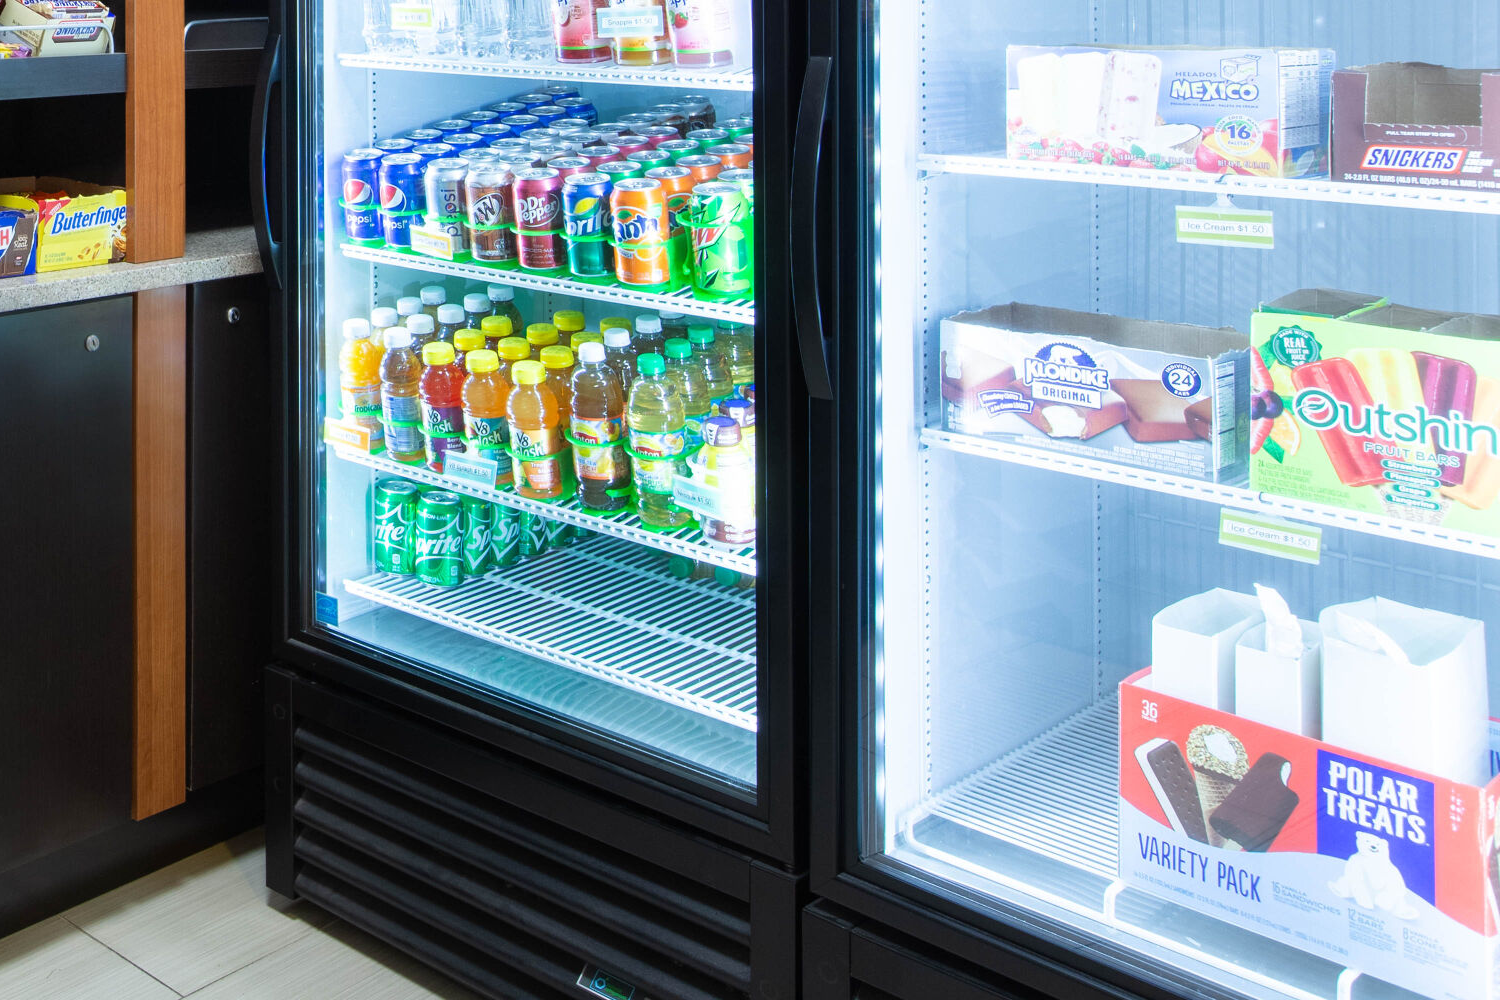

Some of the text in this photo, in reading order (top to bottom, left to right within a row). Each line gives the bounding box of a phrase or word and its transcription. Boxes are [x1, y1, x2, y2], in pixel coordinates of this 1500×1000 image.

[1170, 79, 1260, 102] MEXICO
[1227, 124, 1251, 140] 16
[1367, 148, 1458, 169] SNICKERS
[51, 206, 126, 235] Butterfinge
[347, 214, 372, 225] pepsi
[1187, 222, 1265, 234] Ice Cream $1.50
[1283, 337, 1307, 348] REAL
[1026, 358, 1108, 389] KLONDIKE
[1164, 363, 1198, 377] INDIVIDUAL
[1171, 372, 1192, 387] 24
[1042, 386, 1092, 404] ORIGINAL
[427, 408, 440, 424] V8
[1295, 388, 1499, 456] Outshin
[474, 419, 488, 434] V8
[515, 432, 529, 447] V8
[1364, 442, 1461, 468] FRUIT BARS
[1387, 461, 1437, 476] Strawberry
[1390, 473, 1436, 486] Pineapple
[1391, 495, 1436, 509] Tangerine
[1230, 523, 1311, 548] Ice Cream $1.50
[1141, 700, 1158, 718] 36
[1328, 760, 1419, 813] POLAR
[1322, 786, 1427, 844] TREATS
[1138, 832, 1262, 903] VARIETY PACK
[1271, 881, 1281, 895] 16
[1347, 908, 1357, 921] 12
